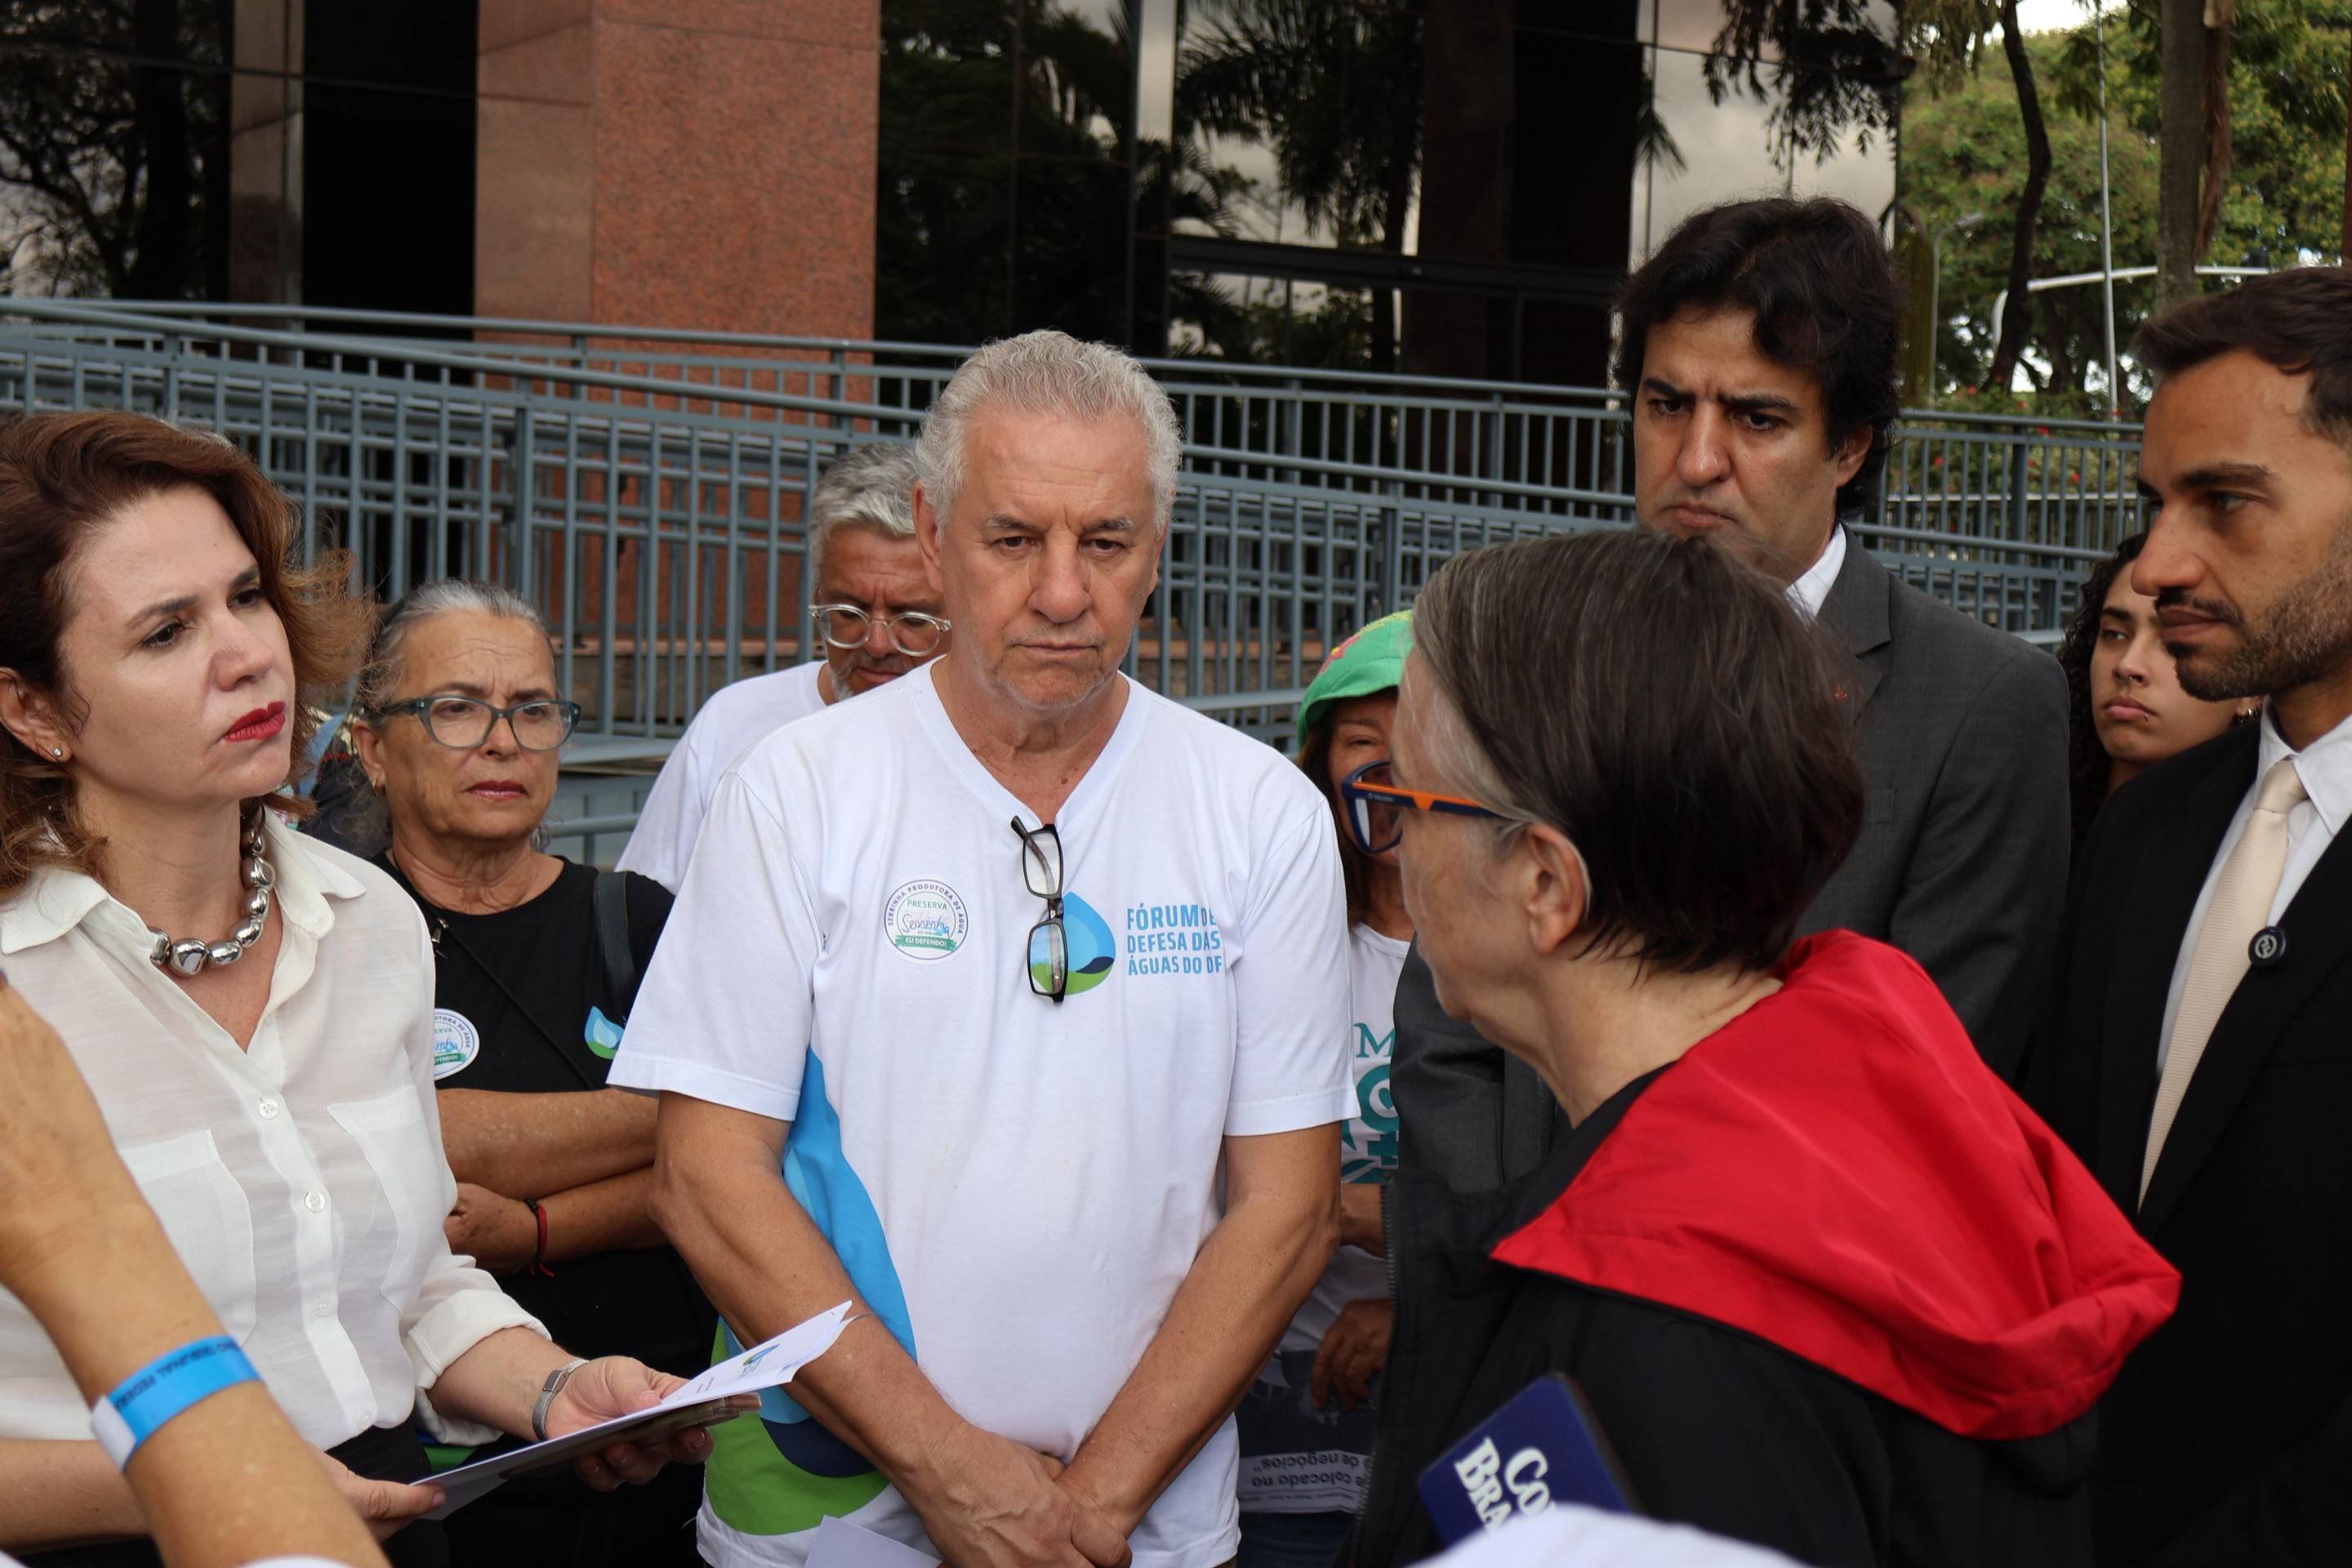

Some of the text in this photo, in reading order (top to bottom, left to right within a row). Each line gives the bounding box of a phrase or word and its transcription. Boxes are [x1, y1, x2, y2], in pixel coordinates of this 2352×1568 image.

[888, 884, 965, 934] SERRINHA PRODUTORA DE ÁGUA
[907, 899, 947, 911] PRESERVA
[1126, 902, 1217, 930] FÓRUM DE
[915, 938, 948, 947] DEFENDO!
[1126, 930, 1221, 954] DEFESA DAS
[1128, 954, 1223, 976] ÁGUAS DO DF
[1341, 1455, 1360, 1470] de
[1250, 1476, 1273, 1487] no
[1279, 1471, 1352, 1488] colocado
